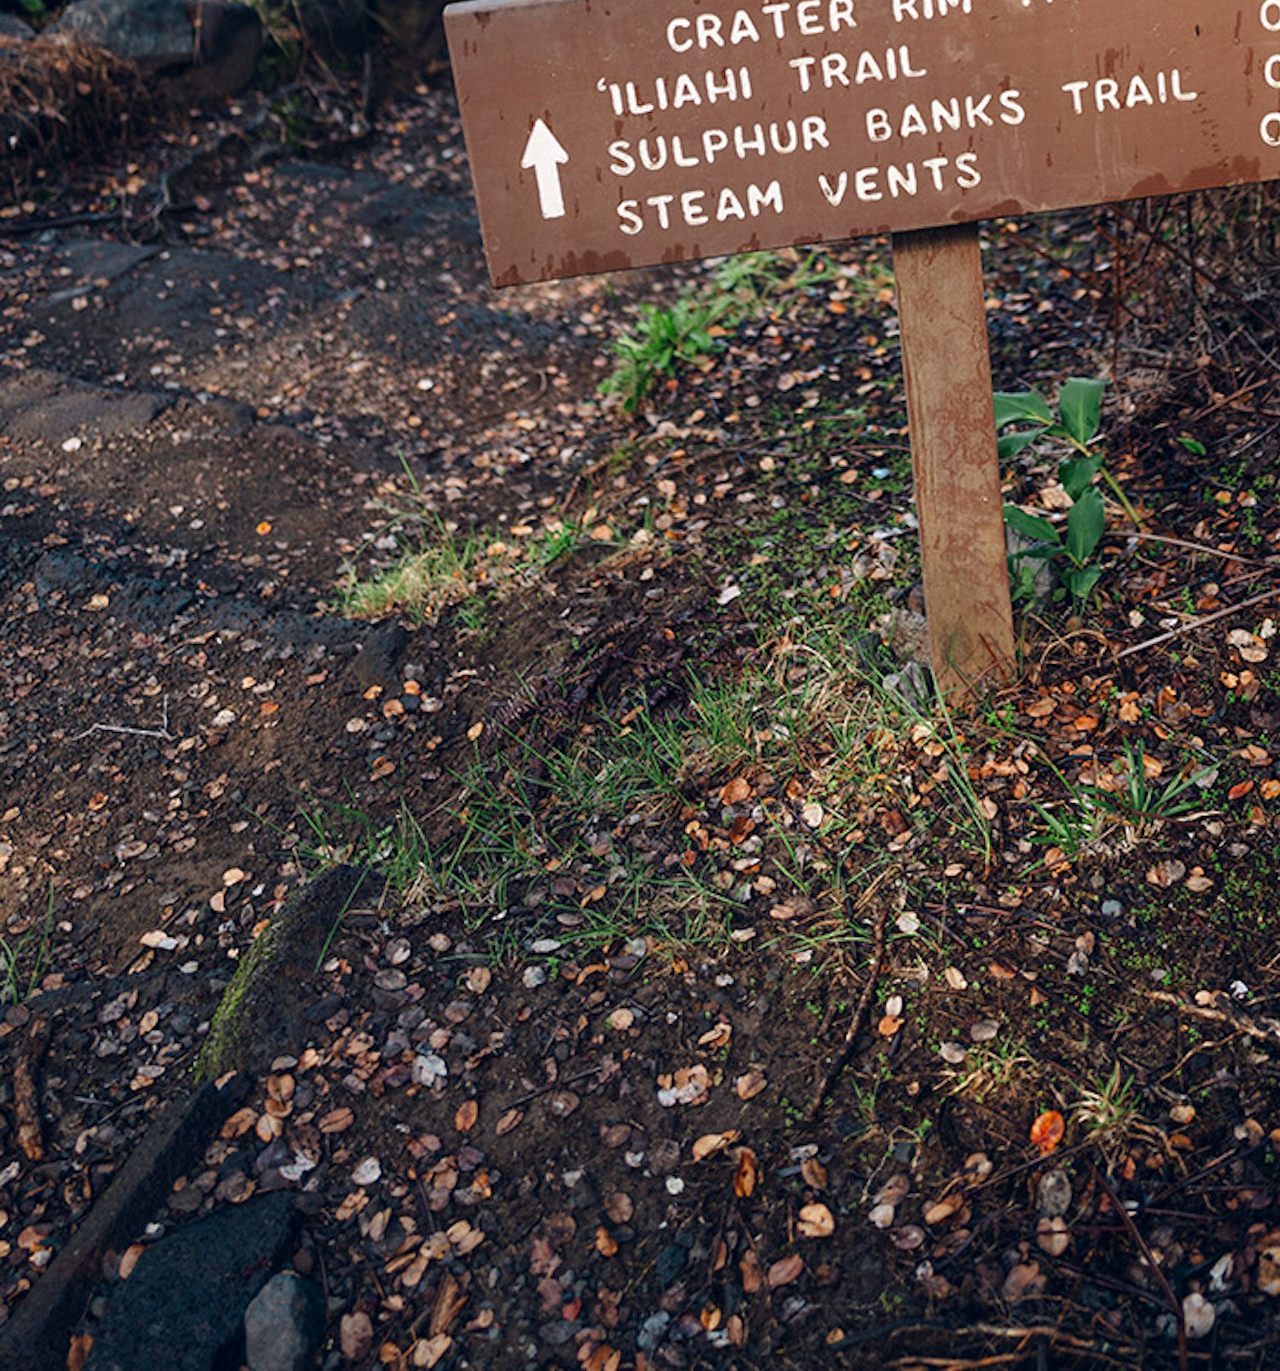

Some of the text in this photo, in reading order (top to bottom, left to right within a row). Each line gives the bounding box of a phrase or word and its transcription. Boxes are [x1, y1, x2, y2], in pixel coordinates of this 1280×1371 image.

[788, 45, 928, 92] TRAIL
[607, 115, 830, 176] SULPHUR
[865, 89, 1025, 142] BANKS
[1061, 68, 1198, 115] TRAIL
[616, 179, 784, 235] STEAM
[818, 152, 982, 207] VENTS
